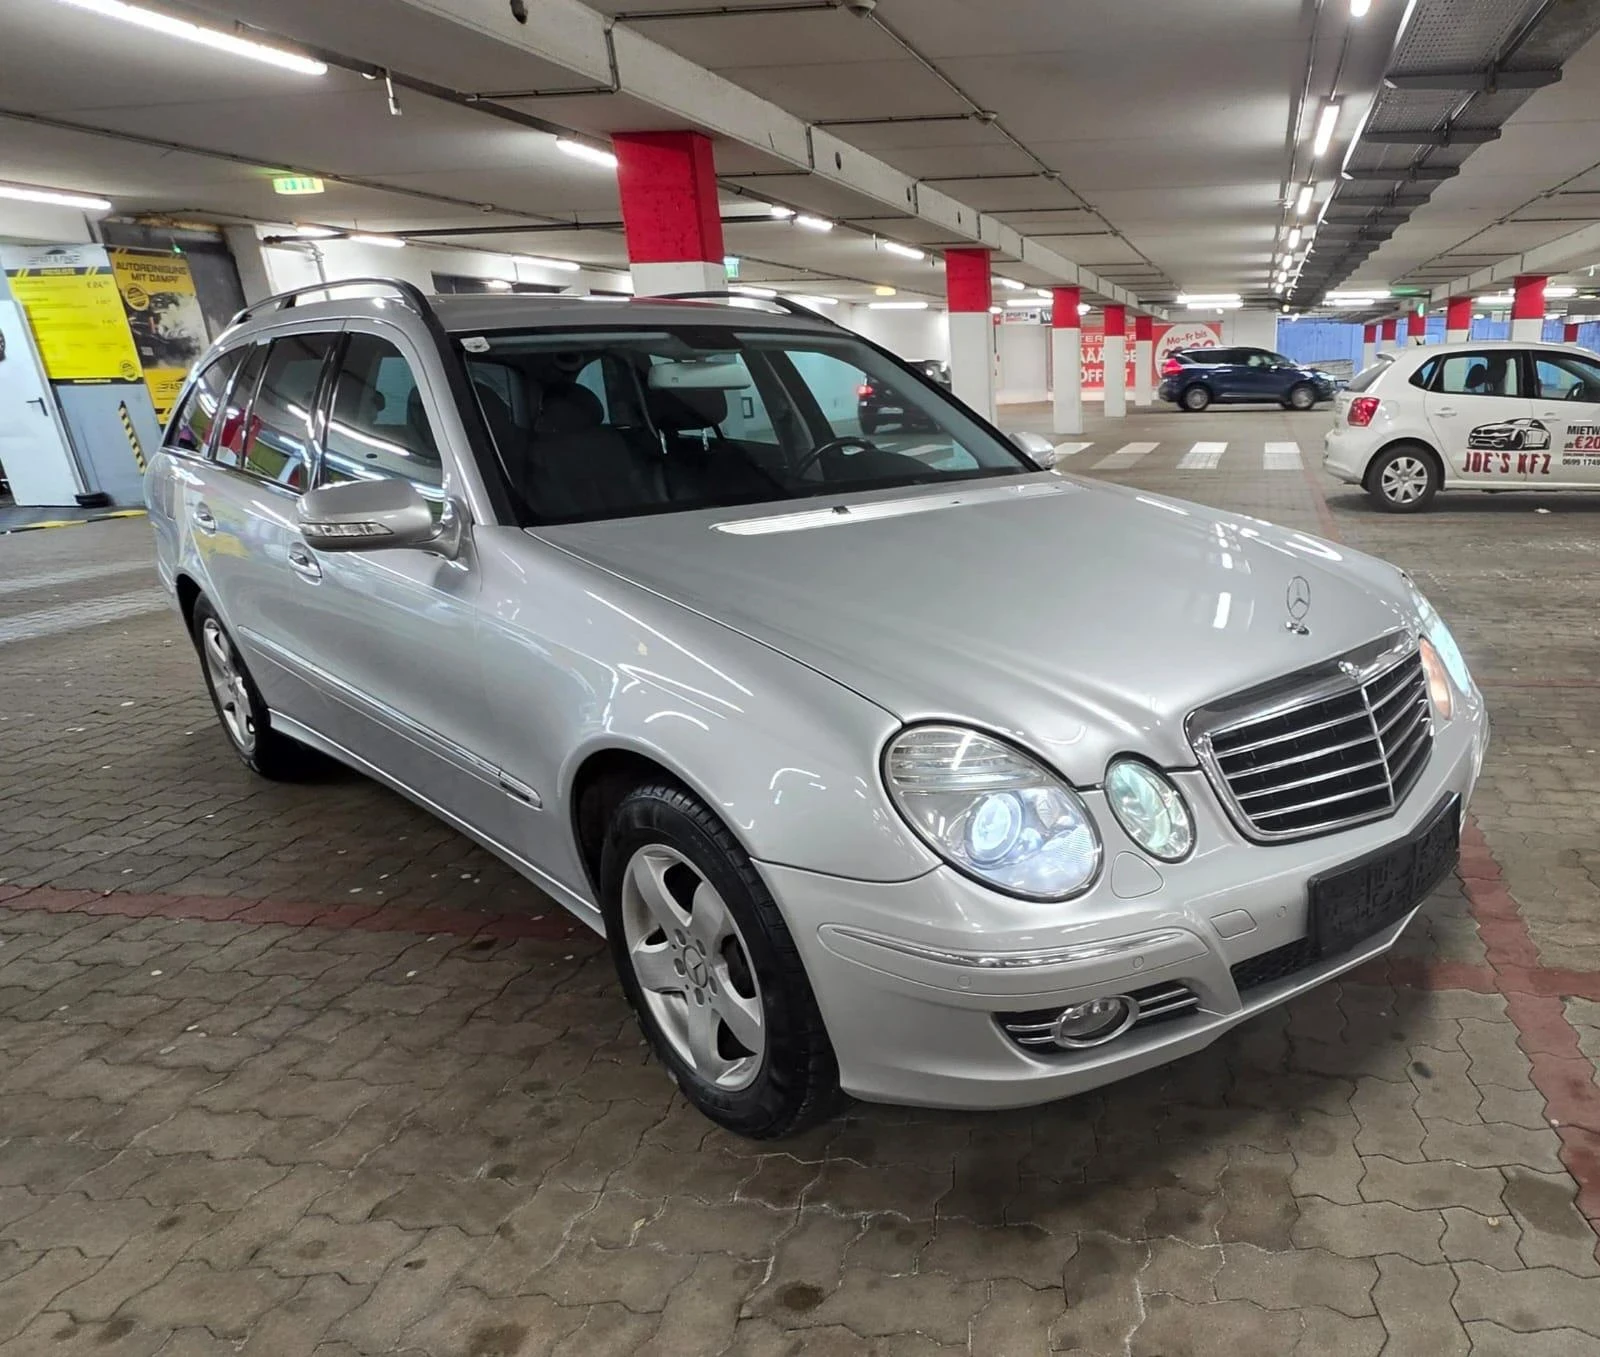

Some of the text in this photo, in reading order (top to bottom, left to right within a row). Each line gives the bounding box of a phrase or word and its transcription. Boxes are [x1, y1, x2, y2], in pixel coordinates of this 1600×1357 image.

[116, 262, 187, 275] AUTOREINIGUNG
[131, 273, 178, 283] MIT DAMPF
[1195, 330, 1207, 339] bis
[1517, 453, 1551, 475] KFZ
